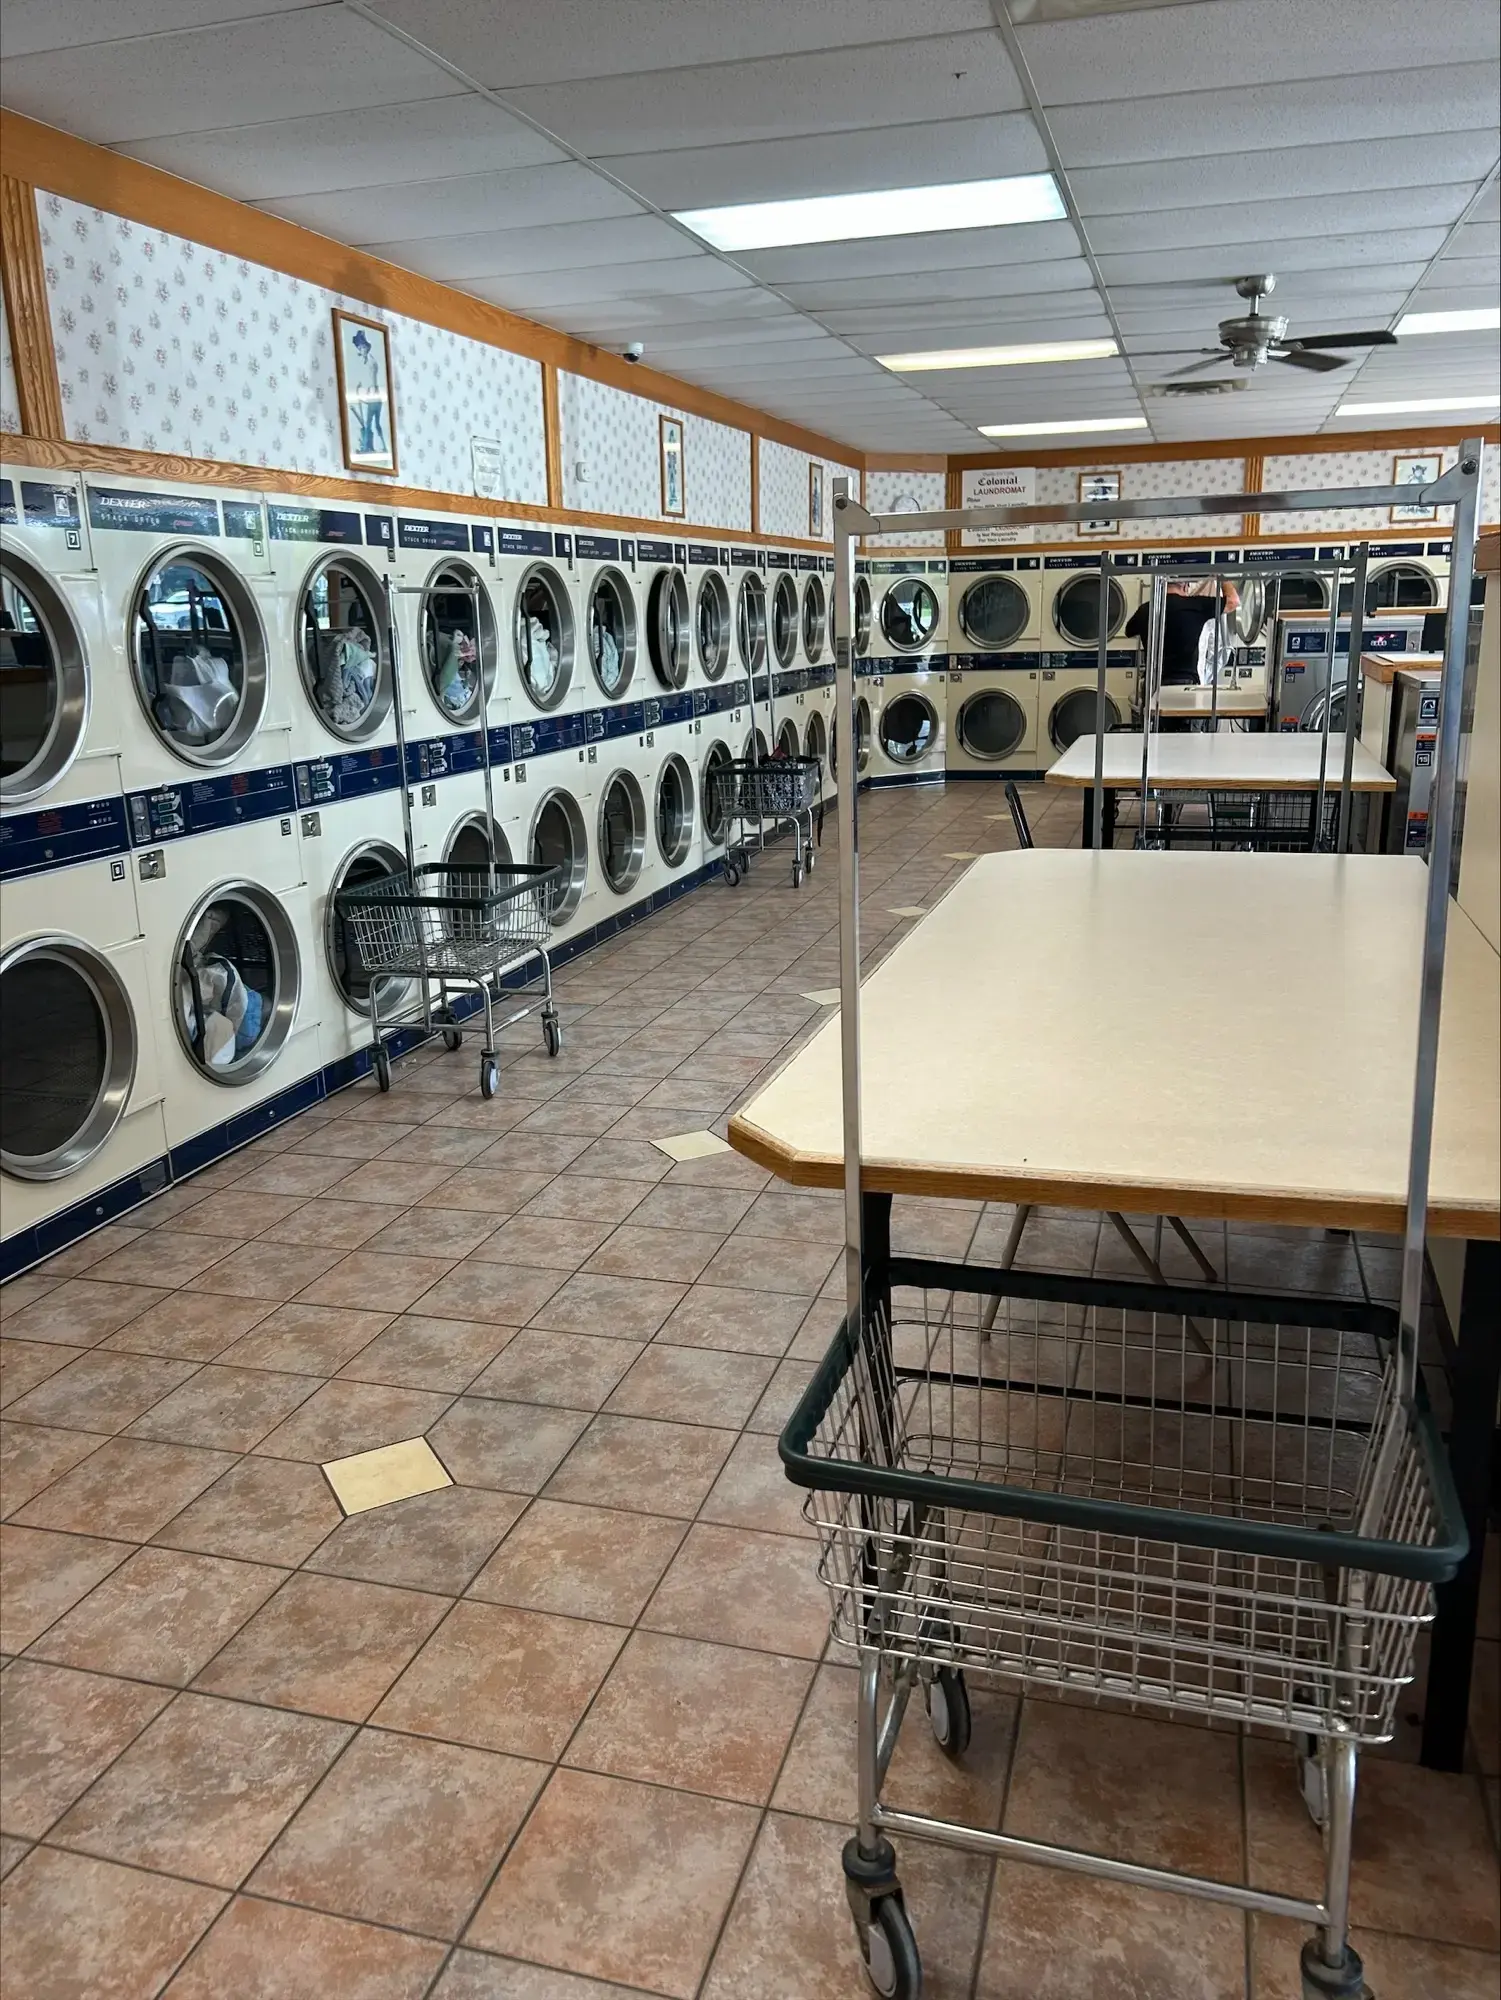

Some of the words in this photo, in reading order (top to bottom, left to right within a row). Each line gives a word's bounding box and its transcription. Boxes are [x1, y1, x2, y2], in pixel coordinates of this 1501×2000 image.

[978, 476, 1018, 486] Colonial
[973, 486, 1026, 496] LAUNDROMAT
[101, 497, 146, 509] DEXTER
[101, 513, 128, 522] STACK
[276, 512, 310, 523] DEXTER
[403, 524, 430, 533] DEXTER
[70, 535, 76, 543] 7
[403, 535, 420, 543] STACK
[422, 537, 437, 545] DRYER
[502, 533, 523, 541] DEXTER
